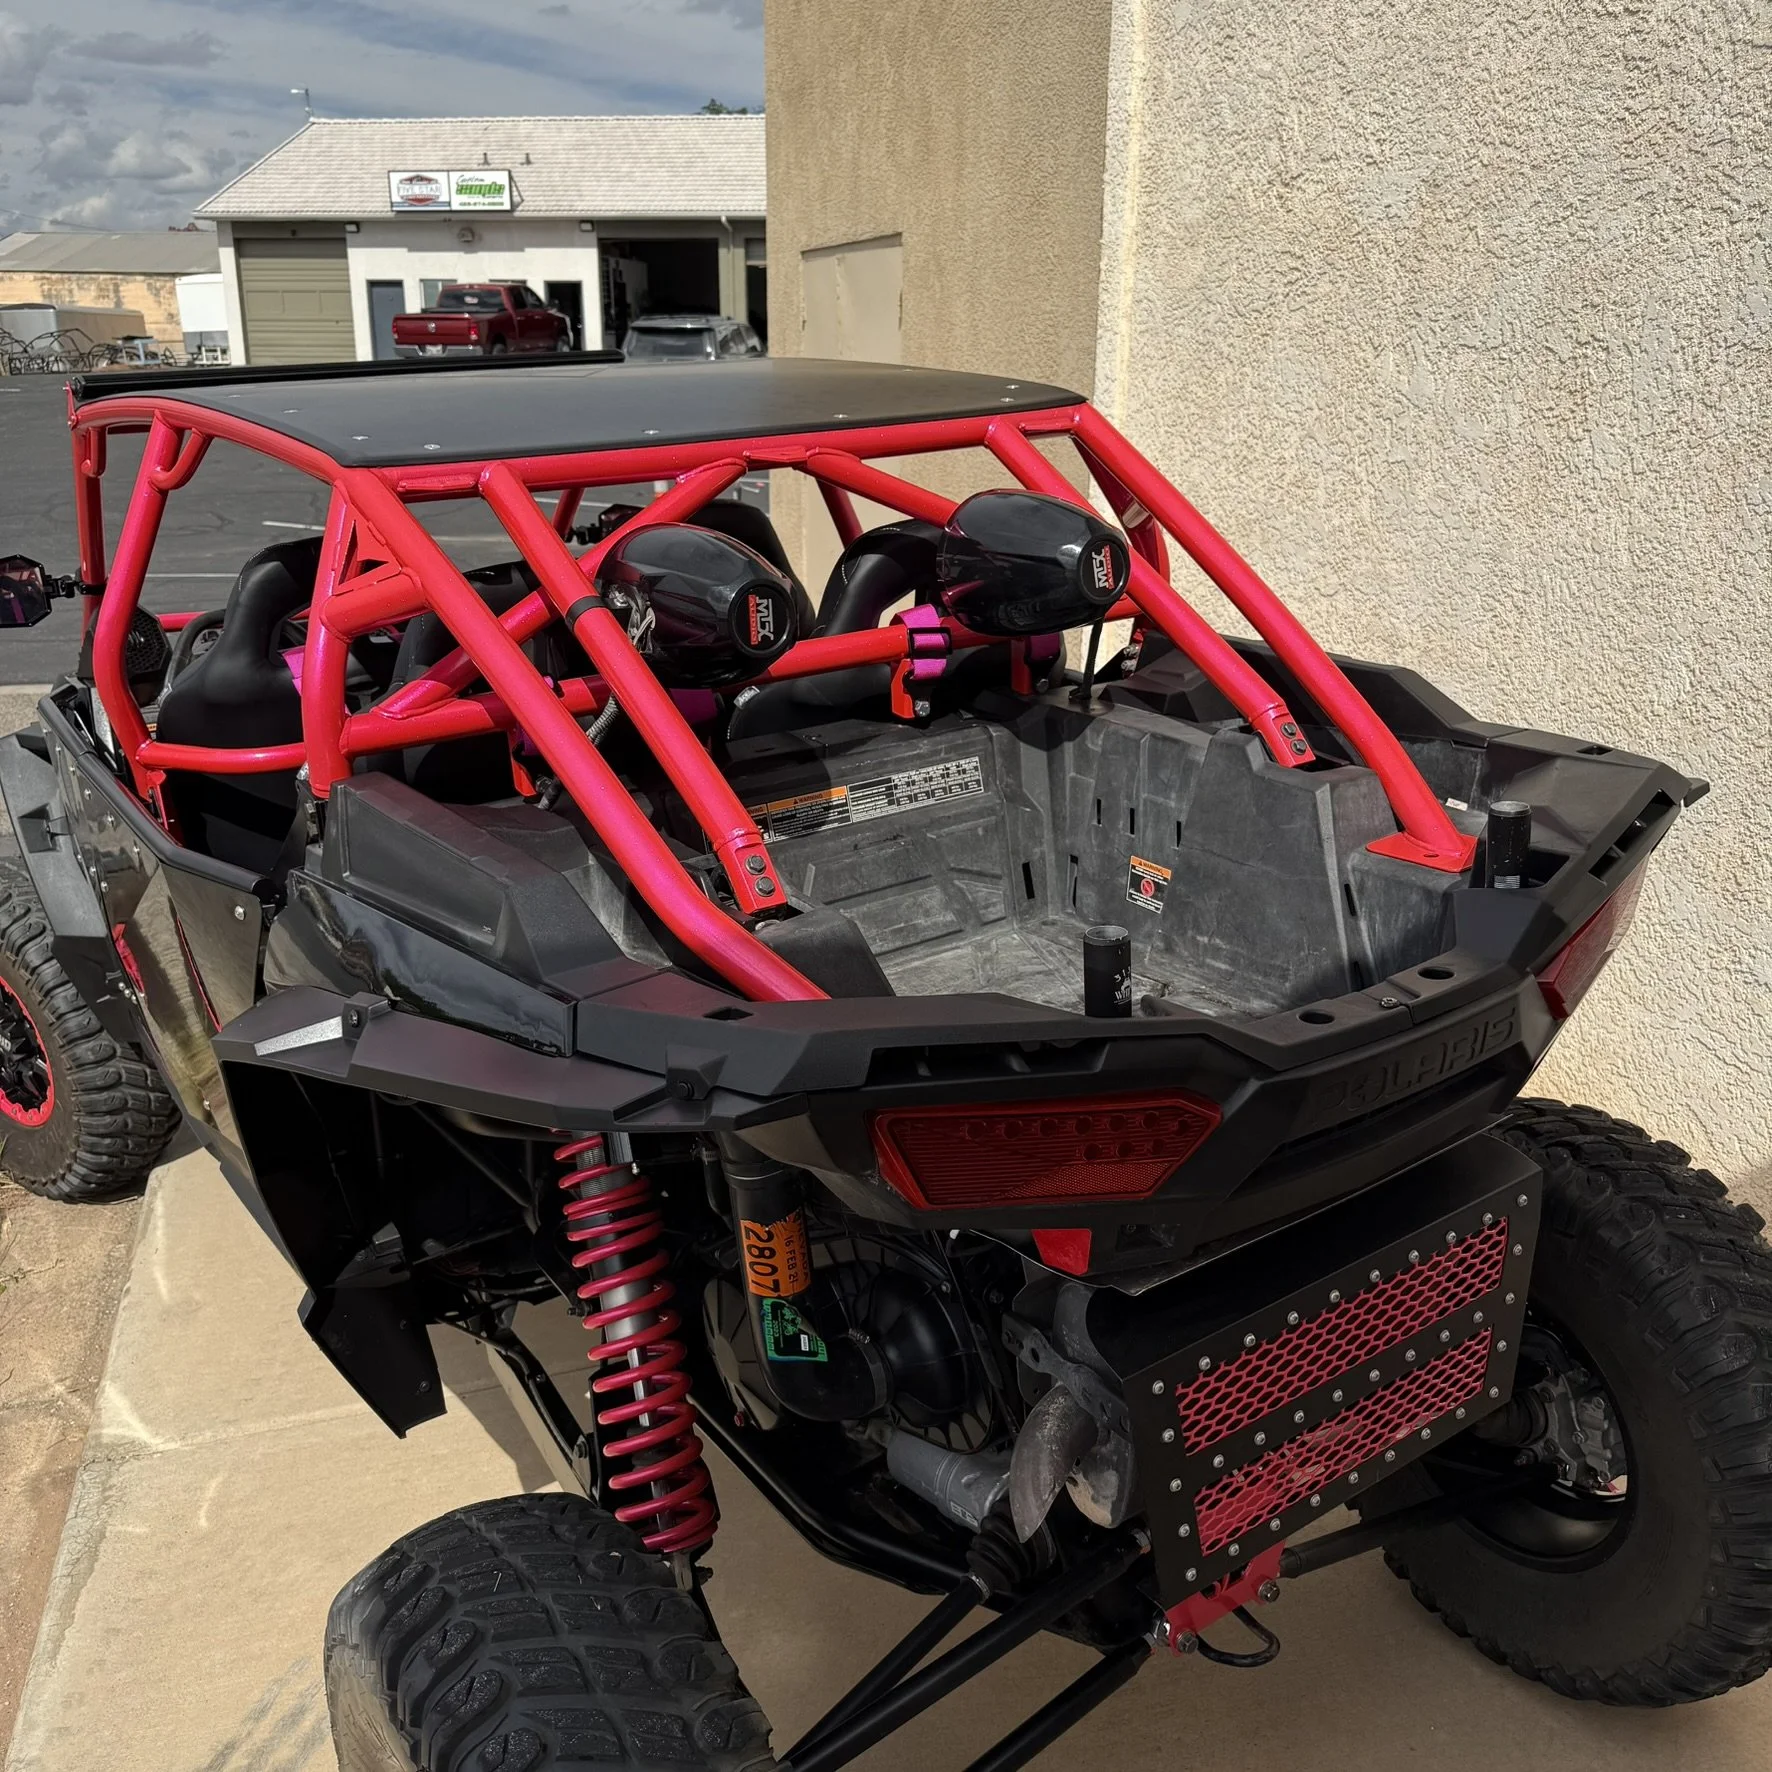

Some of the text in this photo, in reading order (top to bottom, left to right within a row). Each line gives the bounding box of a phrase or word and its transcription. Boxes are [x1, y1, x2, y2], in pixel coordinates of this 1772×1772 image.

[1092, 548, 1109, 589] MTX
[756, 596, 775, 642] MTX
[1311, 1007, 1516, 1114] POLARIS
[744, 1225, 781, 1293] 2807
[786, 1249, 798, 1271] FEB
